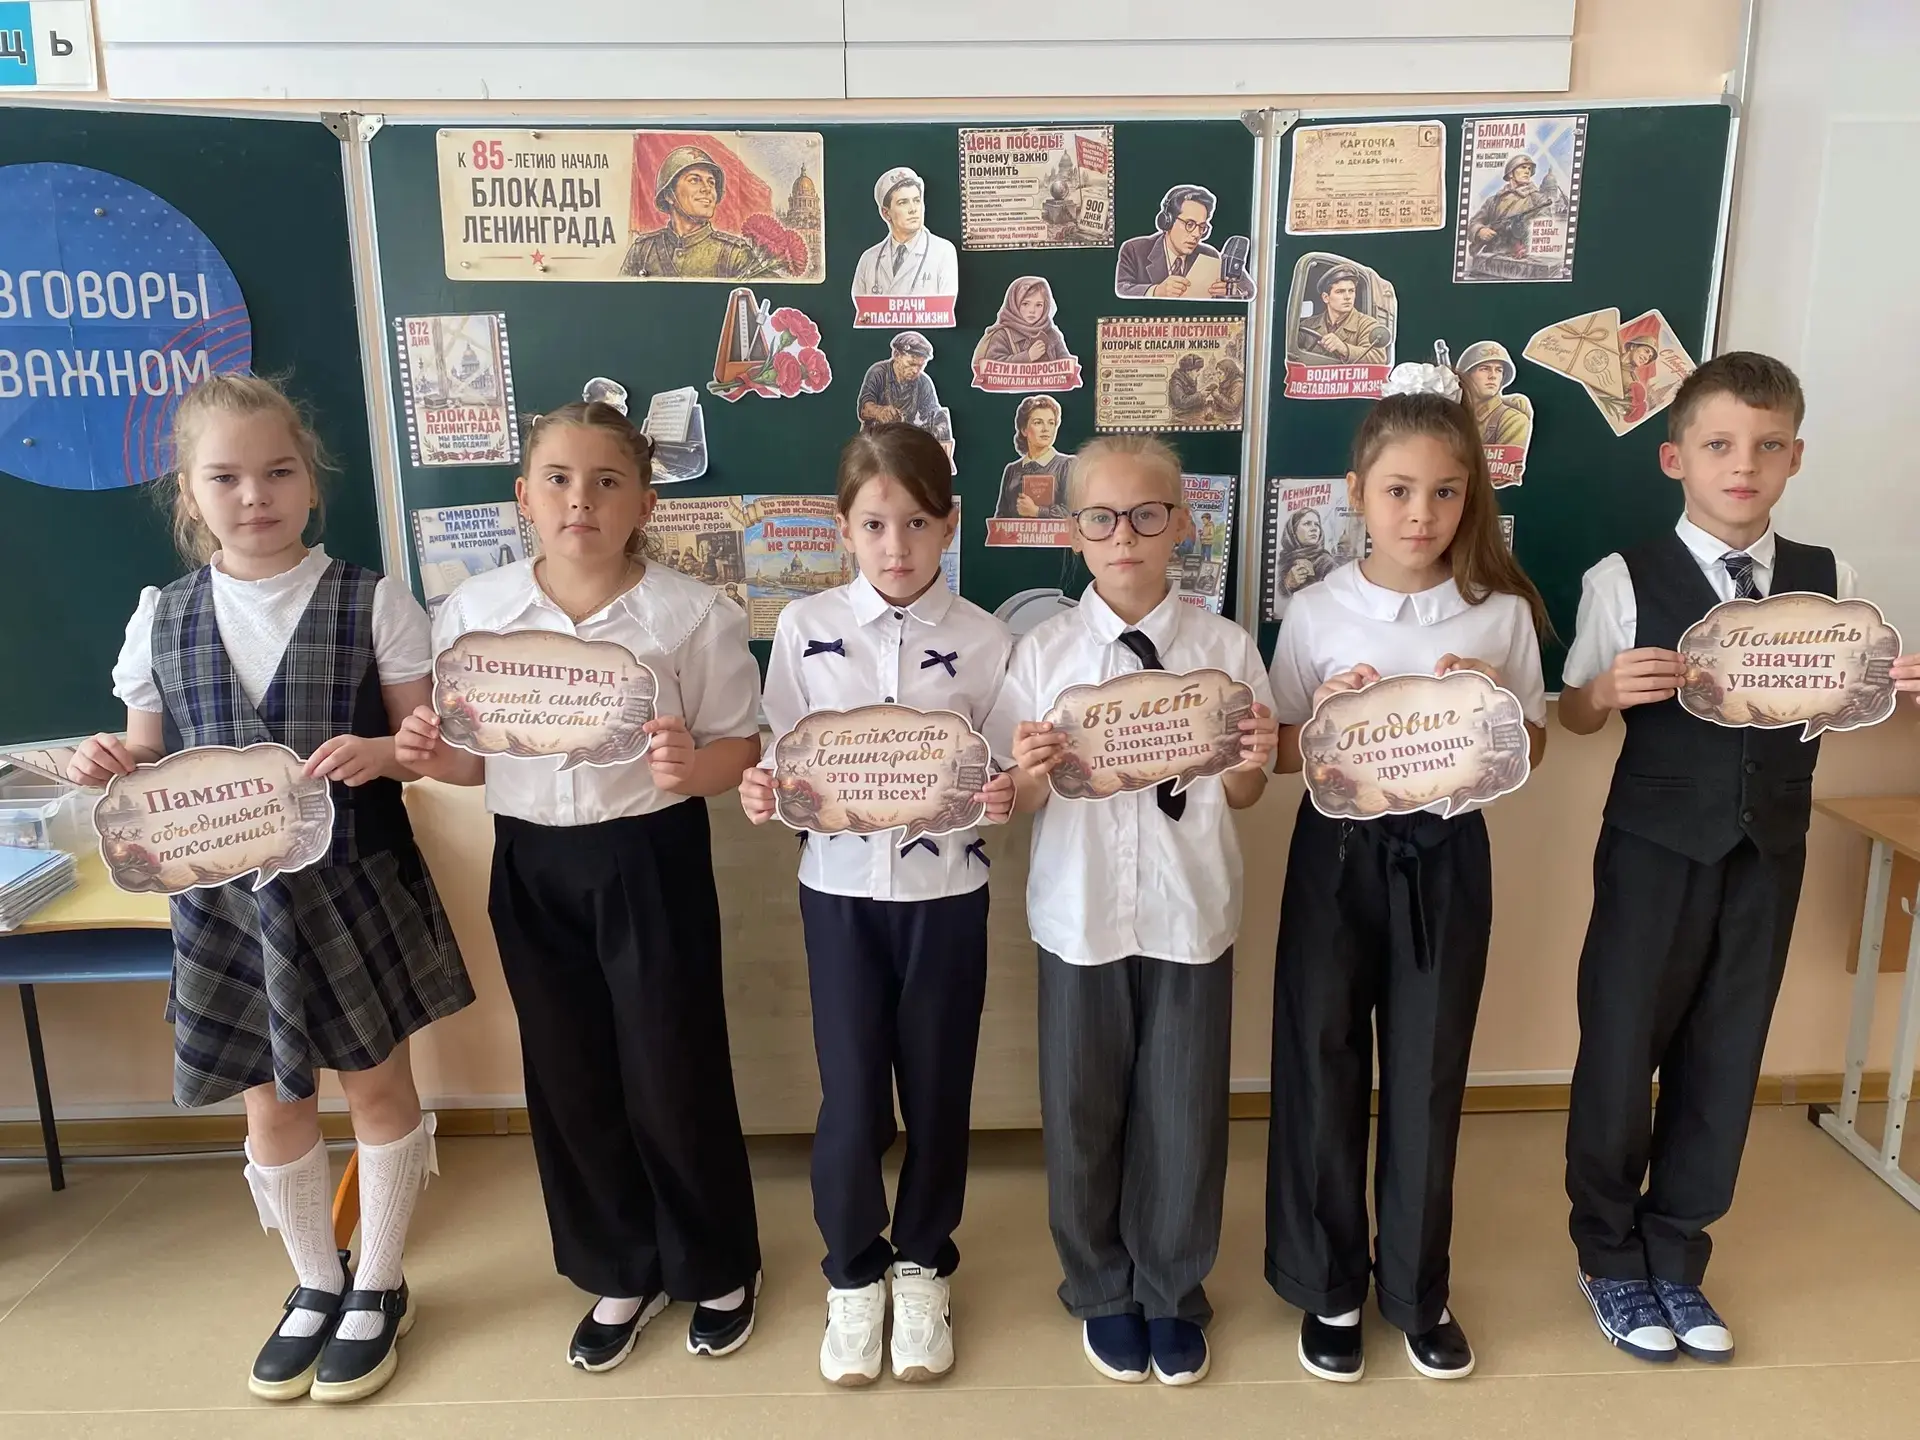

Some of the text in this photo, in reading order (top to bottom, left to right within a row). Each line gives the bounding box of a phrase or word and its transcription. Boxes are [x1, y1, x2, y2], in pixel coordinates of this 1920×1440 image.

[1478, 123, 1526, 137] БЛОКАДА
[967, 132, 1063, 152] Цена победы:
[1340, 138, 1396, 148] КАРТОЧКА
[1476, 138, 1525, 149] ЛЕНИНГРАДА
[457, 152, 467, 168] К
[561, 153, 609, 169] НАЧАЛА
[969, 152, 1048, 165] почему важно
[969, 166, 1019, 176] помнить
[471, 177, 601, 212] БЛОКАДЫ
[1086, 199, 1104, 213] 900
[1357, 208, 1369, 217] 125
[1379, 207, 1390, 216] 125
[1400, 207, 1411, 216] 125
[1420, 206, 1431, 215] 125
[1084, 212, 1101, 221] ДНЕЙ
[1295, 210, 1306, 219] 125
[1316, 209, 1327, 218] 125
[1336, 209, 1348, 218] 125
[463, 215, 616, 248] ЛЕНИНГРАДА
[1532, 228, 1539, 236] НЕ
[889, 299, 925, 310] ВРАЧИ
[915, 311, 949, 324] ЖИЗНИ
[408, 321, 429, 336] 872
[1102, 325, 1169, 338] МАЛЕНЬКИЕ
[411, 336, 431, 347] ДНЯ
[1102, 339, 1220, 350] КОТОРЫЕ СПАСАЛИ ЖИЗНЬ
[0, 349, 211, 397] ВАЖНОМ
[984, 360, 1071, 376] ДЕТИ И ПОДРОСТКИ
[1307, 368, 1369, 382] ВОДИТЕЛИ
[988, 375, 1025, 386] ПОМОГАЛИ
[1027, 375, 1041, 386] КАК
[1290, 381, 1349, 395] ДОСТАВЛЯЛИ
[426, 408, 501, 423] БЛОКАДА
[426, 422, 502, 434] ЛЕНИНГРАДА
[452, 434, 491, 442] ВЫСТОЯЛИ!
[452, 441, 491, 449] ПОБЕДИЛИ!
[1282, 484, 1332, 502] ЛЕНИНГРАД
[652, 500, 729, 511] ти блокадного
[760, 501, 775, 509] Что
[1287, 495, 1330, 512] ВЫСТОЯЛ!
[438, 507, 500, 521] СИМВОЛЫ
[763, 507, 791, 515] начало
[445, 518, 499, 533] ПАМЯТИ:
[645, 521, 731, 533] маленькие герои
[763, 522, 836, 540] Ленинград
[995, 522, 1038, 533] УЧИТЕЛЯ
[429, 526, 517, 544] ДНЕВНИК ТАНИ САВИЧЕВОЙ
[1016, 532, 1055, 544] ЗНАНИЯ
[458, 538, 499, 549] МЕТРОНОМ
[767, 540, 835, 552] не сдался!
[1720, 623, 1862, 649] Помнить
[1741, 652, 1836, 668] значит
[464, 654, 616, 688] Ленинград
[1726, 671, 1847, 692] уважать!
[466, 688, 625, 708] вечный символ
[1082, 683, 1208, 729] 85 лет
[479, 707, 610, 727] стойкости!
[1104, 717, 1191, 738] с начала
[1336, 708, 1460, 751] Подвиг
[818, 725, 949, 747] Стойкость
[1104, 731, 1194, 753] блокады
[806, 742, 945, 768] Ленинграда
[1091, 743, 1211, 770] Ленинграда
[1352, 748, 1388, 765] это
[1391, 734, 1474, 759] помощь
[1377, 752, 1457, 781] другим!
[826, 771, 939, 787] это пример
[142, 777, 274, 815] Память
[836, 787, 928, 803] для всех!
[150, 798, 285, 844] объединяет
[159, 816, 286, 863] поколения!
